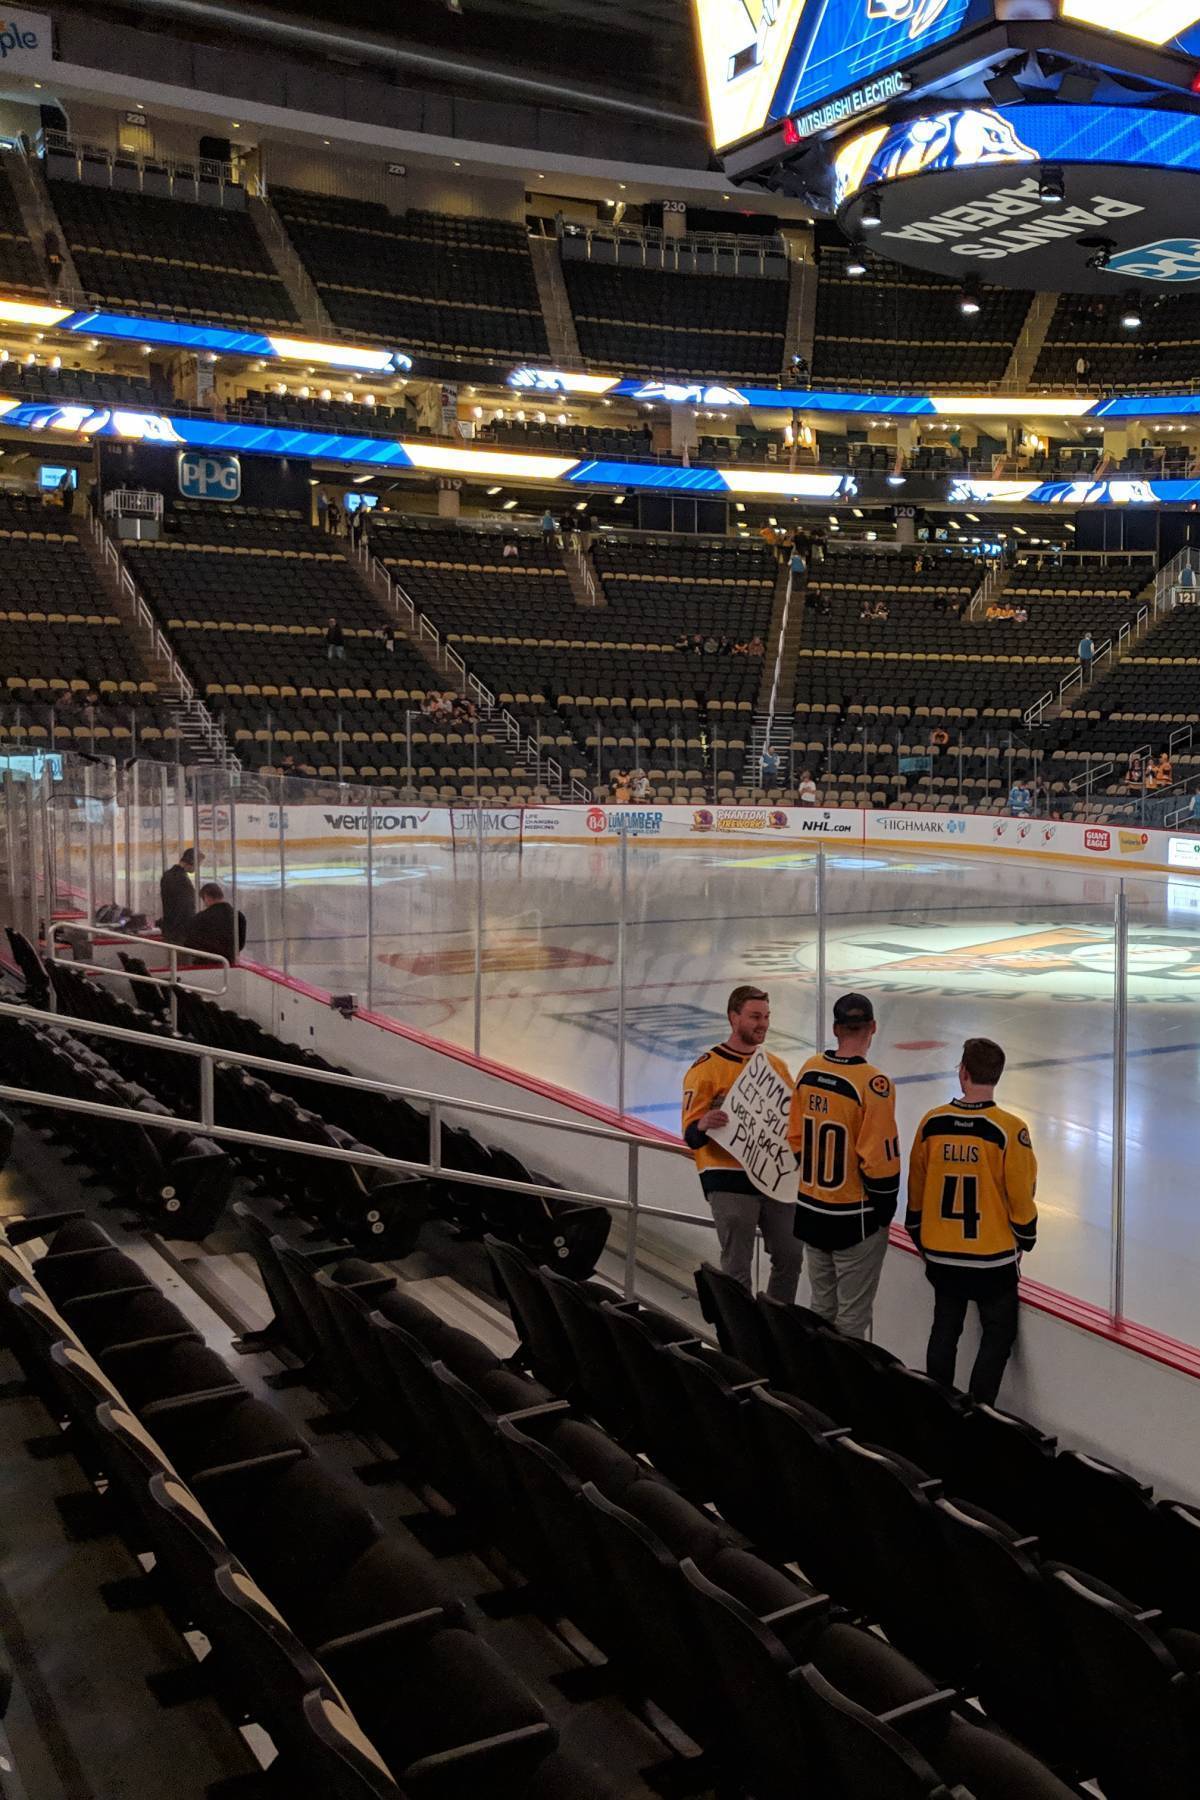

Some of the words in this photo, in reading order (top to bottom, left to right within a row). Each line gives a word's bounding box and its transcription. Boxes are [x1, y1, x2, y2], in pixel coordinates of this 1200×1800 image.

[796, 96, 851, 137] MITSUBISHI
[852, 71, 905, 111] ELECTRIC
[663, 201, 686, 213] 230
[881, 177, 1047, 244] ARENA
[950, 195, 1146, 259] PAINTS
[183, 459, 237, 494] PPG
[894, 505, 916, 517] 120
[1178, 592, 1196, 603] 121
[324, 811, 418, 830] verizon
[717, 809, 766, 820] PHANTOM
[876, 816, 944, 833] HIGHMARK
[1086, 831, 1109, 841] GIANT
[1086, 839, 1109, 848] EAGLE
[738, 1075, 765, 1115] LET'S
[730, 1096, 756, 1134] UBER
[757, 1129, 788, 1167] BACK
[729, 1123, 790, 1192] PHILLY
[802, 1115, 848, 1191] 10
[943, 1143, 980, 1163] ELLIS
[941, 1174, 981, 1240] 4
